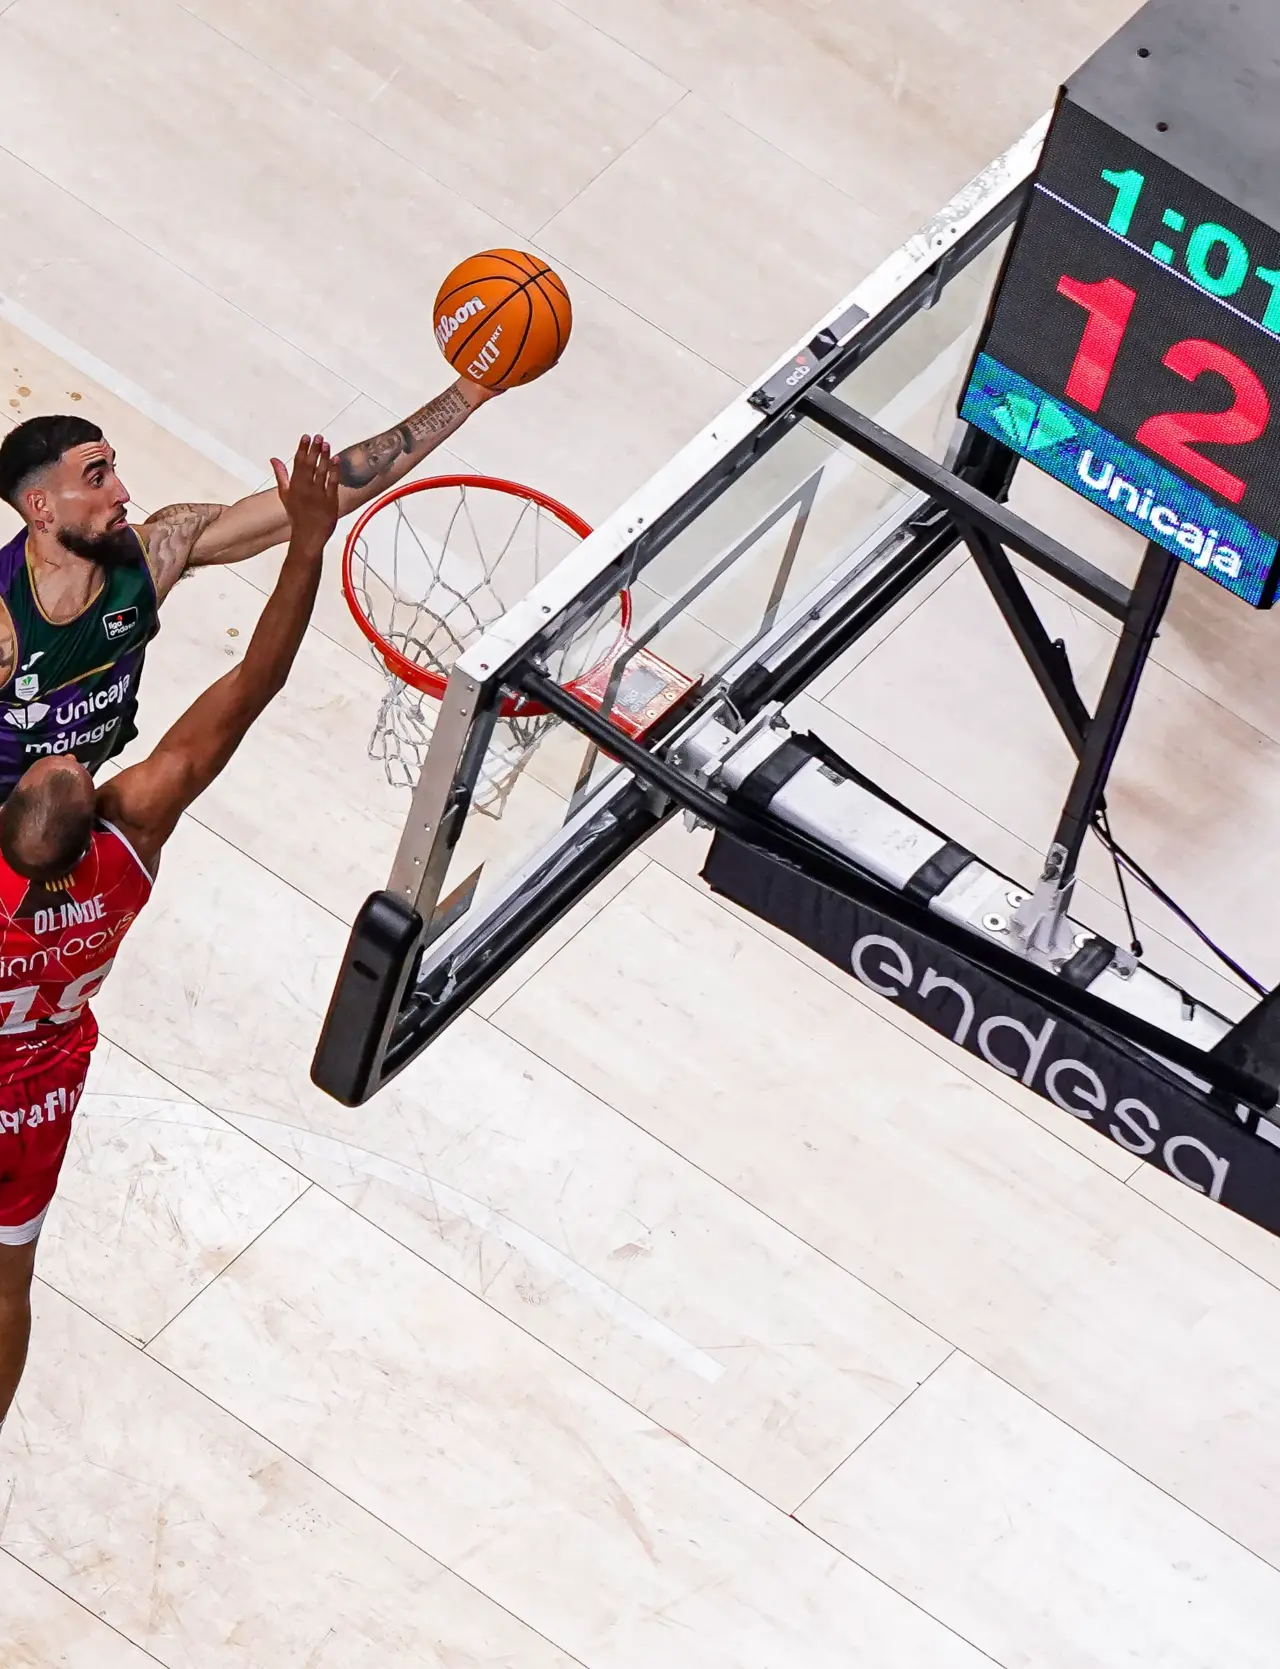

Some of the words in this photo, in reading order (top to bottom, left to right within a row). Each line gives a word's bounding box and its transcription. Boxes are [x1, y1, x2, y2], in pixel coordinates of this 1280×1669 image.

[786, 364, 811, 386] acb
[1056, 274, 1269, 503] 12
[1077, 449, 1242, 577] Unicaja
[56, 674, 130, 725] Unicaja
[34, 893, 107, 935] OLINDE
[850, 934, 1230, 1201] endesa
